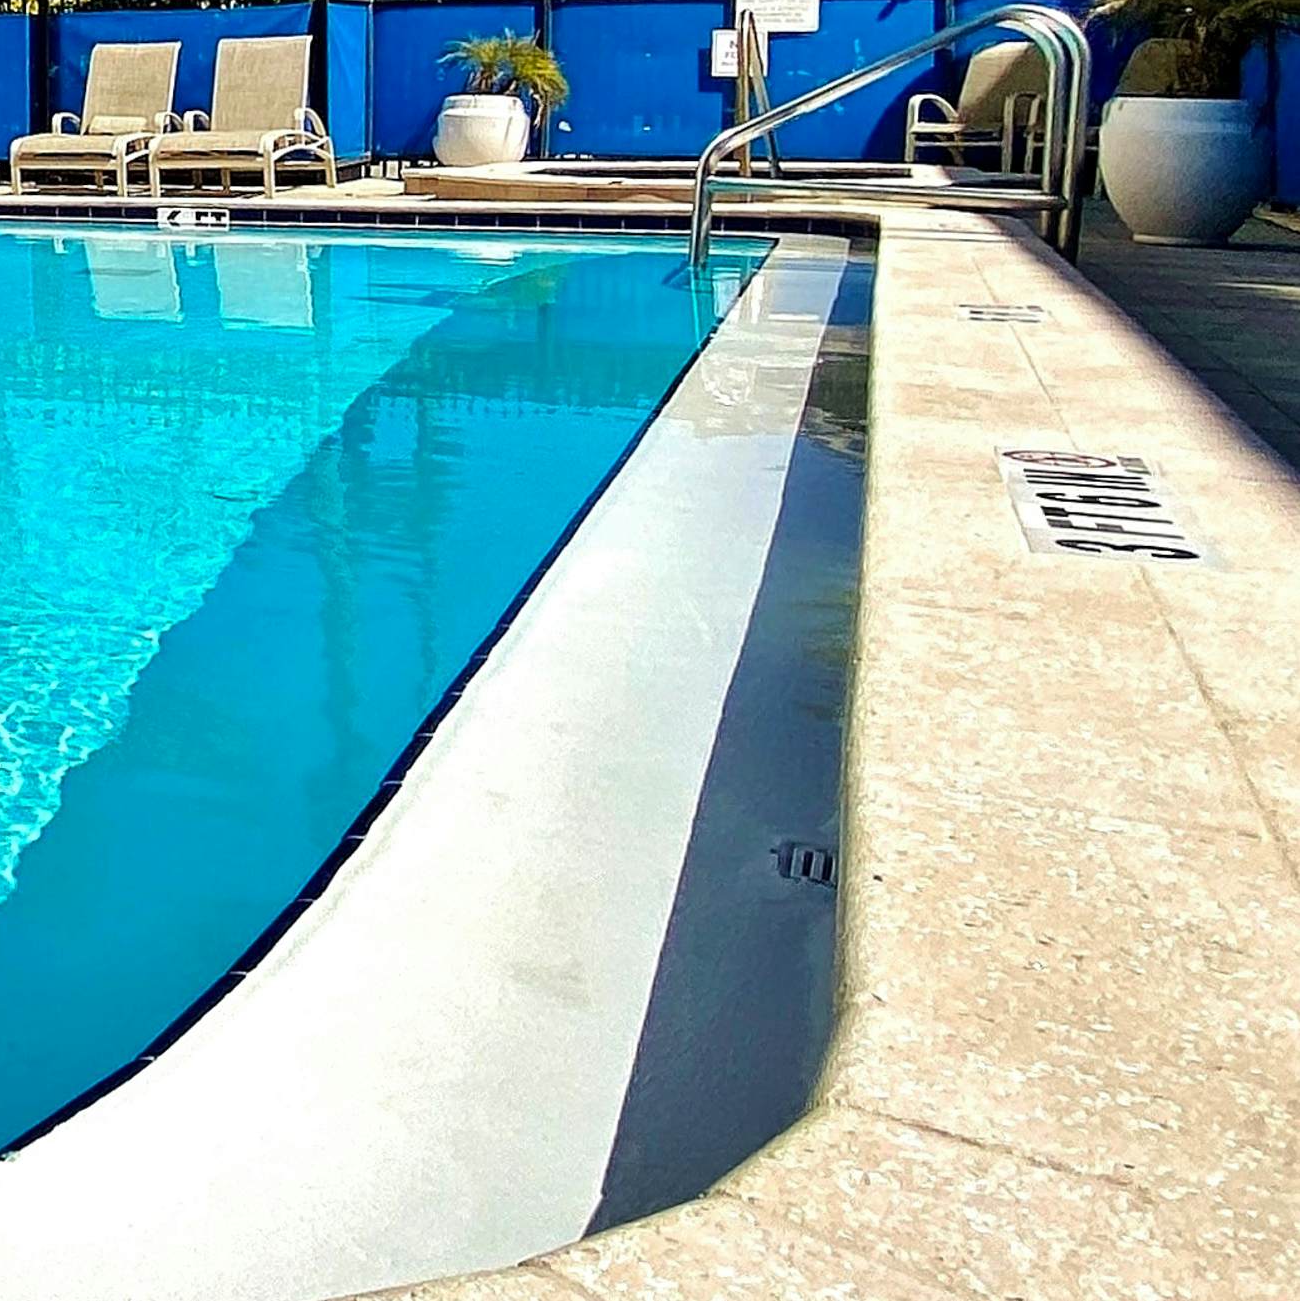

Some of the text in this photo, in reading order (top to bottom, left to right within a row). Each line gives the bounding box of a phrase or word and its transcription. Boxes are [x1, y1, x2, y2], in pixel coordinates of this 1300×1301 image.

[1023, 468, 1200, 559] 3 FT 6 IN
